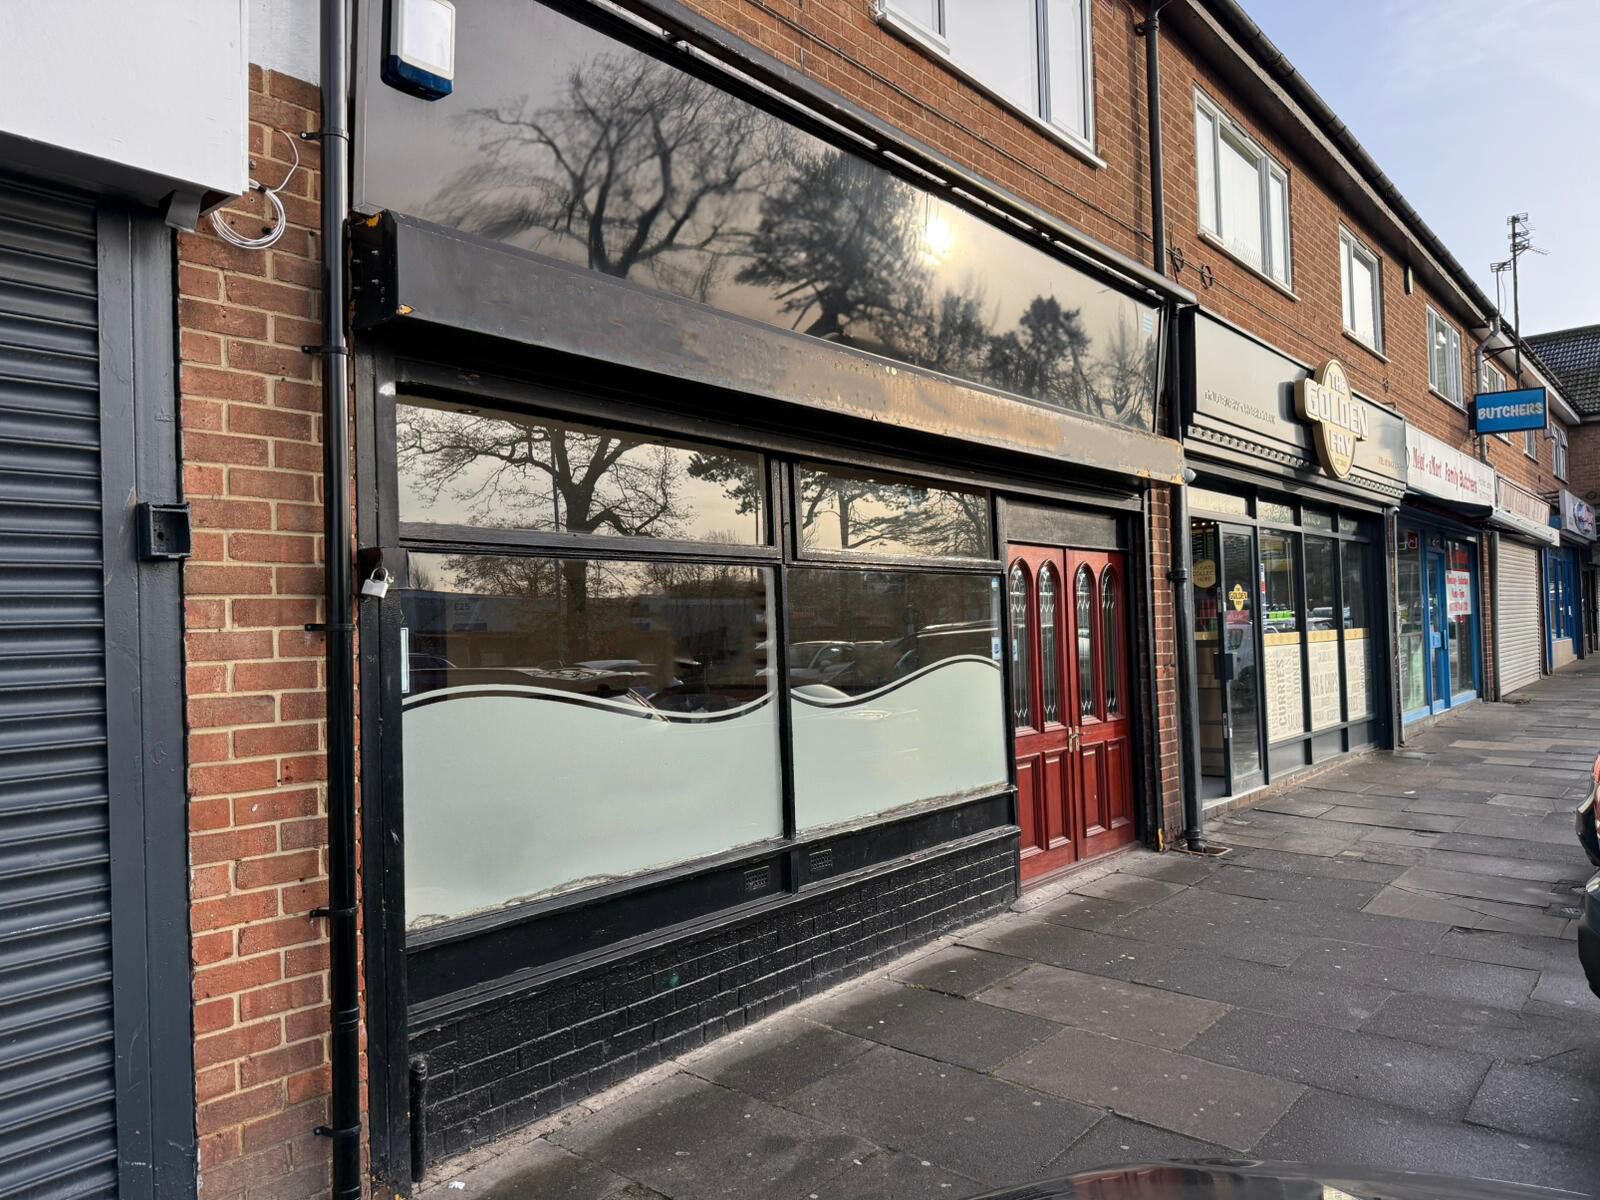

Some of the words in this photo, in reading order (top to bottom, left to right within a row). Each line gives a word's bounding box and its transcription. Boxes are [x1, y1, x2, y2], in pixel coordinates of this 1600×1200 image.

[1328, 371, 1346, 396] THE
[1305, 379, 1368, 439] GOLDEN
[1477, 402, 1544, 420] BUTCHERS
[1328, 430, 1351, 457] FRY
[1459, 469, 1478, 494] Butchers
[1292, 647, 1301, 694] DONER
[1276, 659, 1288, 727] CURRIES
